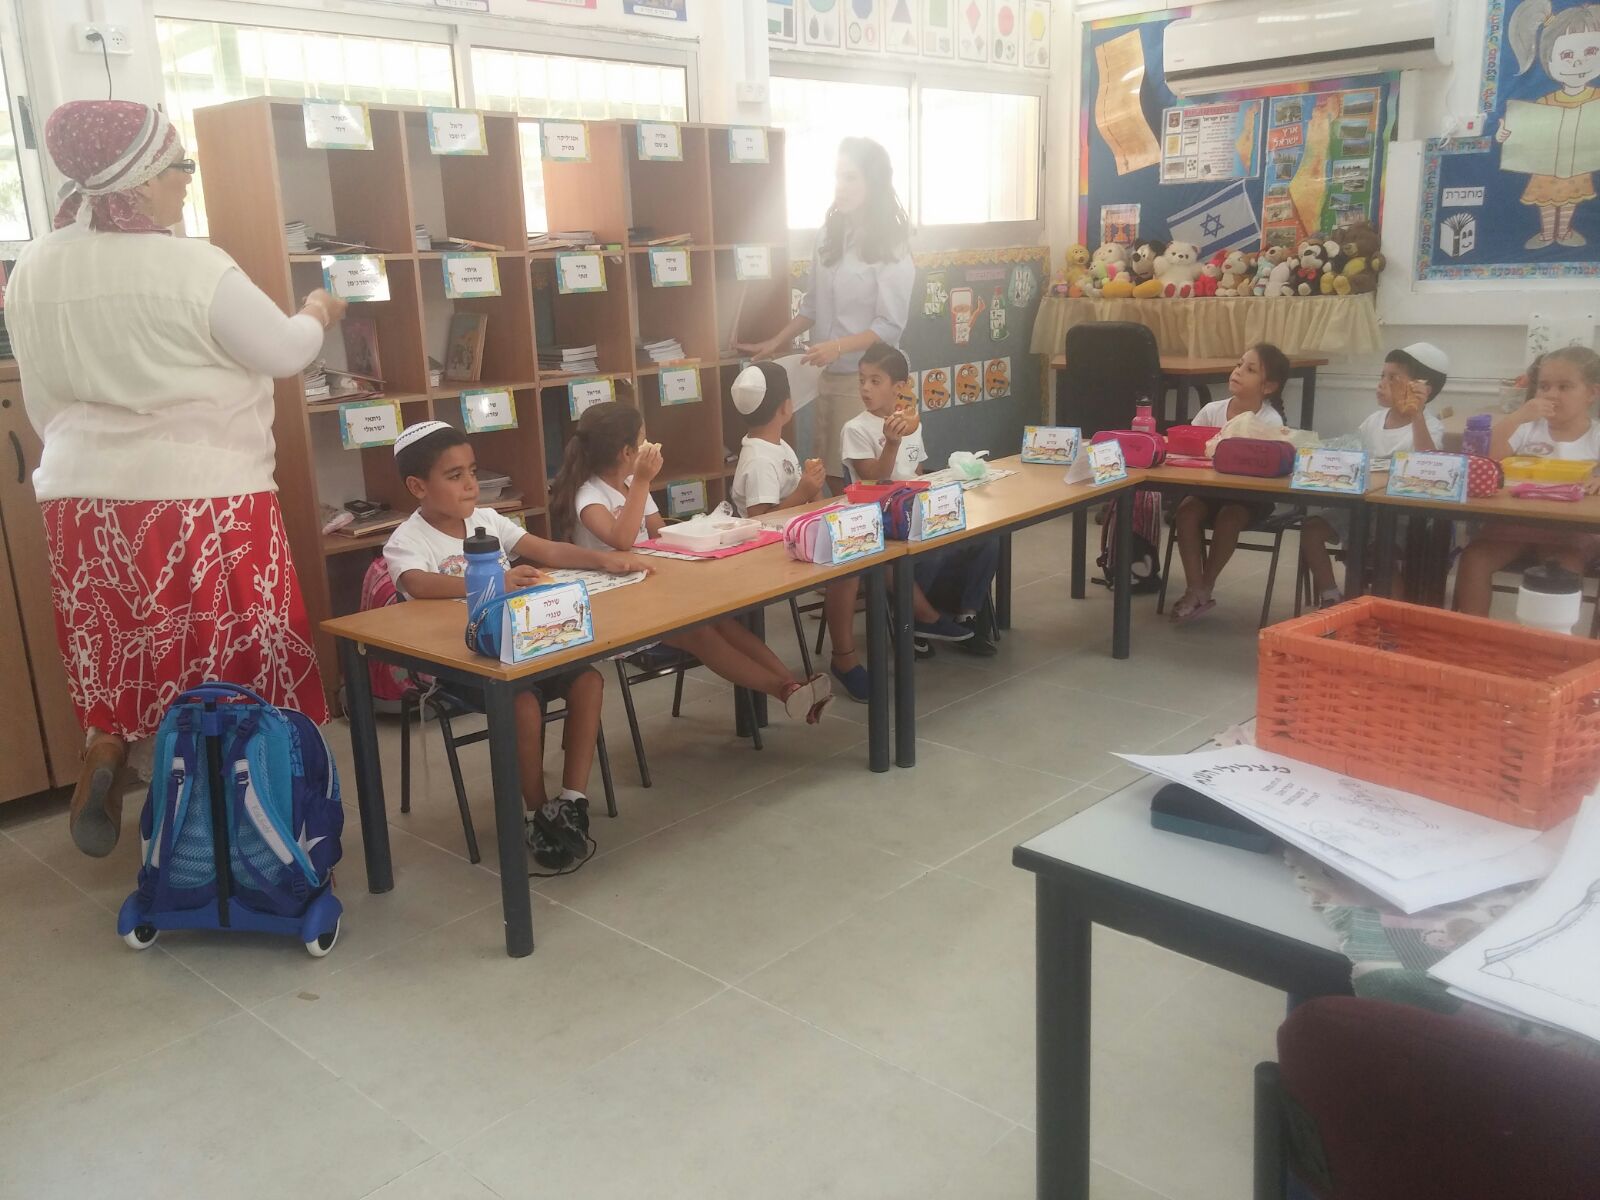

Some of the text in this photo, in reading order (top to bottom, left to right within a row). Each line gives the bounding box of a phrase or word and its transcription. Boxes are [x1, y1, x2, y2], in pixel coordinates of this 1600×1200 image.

[1281, 126, 1298, 138] ארץ
[1271, 136, 1299, 148] ישראל
[1445, 190, 1483, 199] מחברת
[543, 598, 560, 607] שילה
